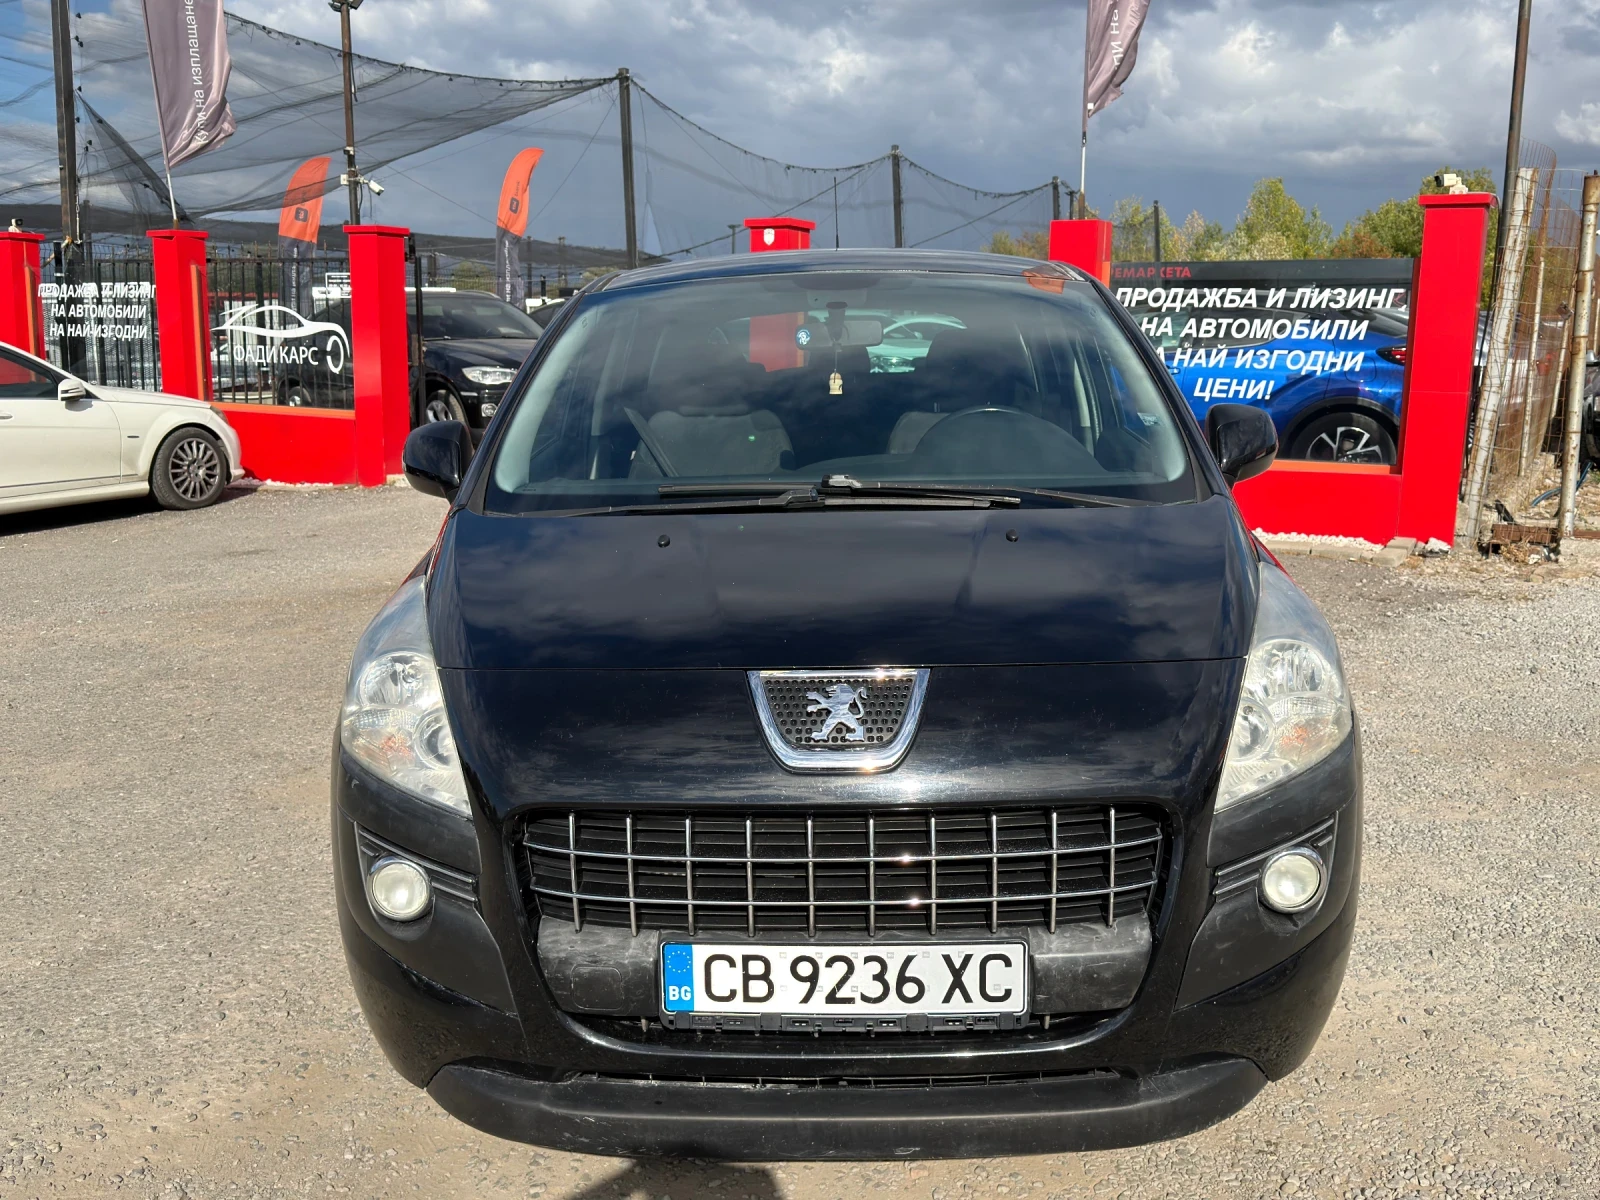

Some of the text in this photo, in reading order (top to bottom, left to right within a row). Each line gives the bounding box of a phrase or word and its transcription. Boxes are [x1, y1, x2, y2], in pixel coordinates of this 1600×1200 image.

[1110, 9, 1120, 34] на
[194, 90, 205, 111] на
[51, 303, 147, 319] НА АВТОМОБИЛИ
[1115, 287, 1258, 313] ПРОДАЖБА
[1265, 287, 1287, 309] И
[49, 323, 66, 337] НА
[1141, 316, 1370, 341] НА АВТОМОБИЛИ
[233, 344, 319, 366] ФАДИ КАРС
[1172, 343, 1228, 369] НАЙ
[1233, 348, 1366, 376] ИЗГОДНИ
[1193, 377, 1275, 402] ЦЕНИ!
[704, 953, 1013, 1005] CB 9236 XC
[668, 985, 692, 1001] BG
